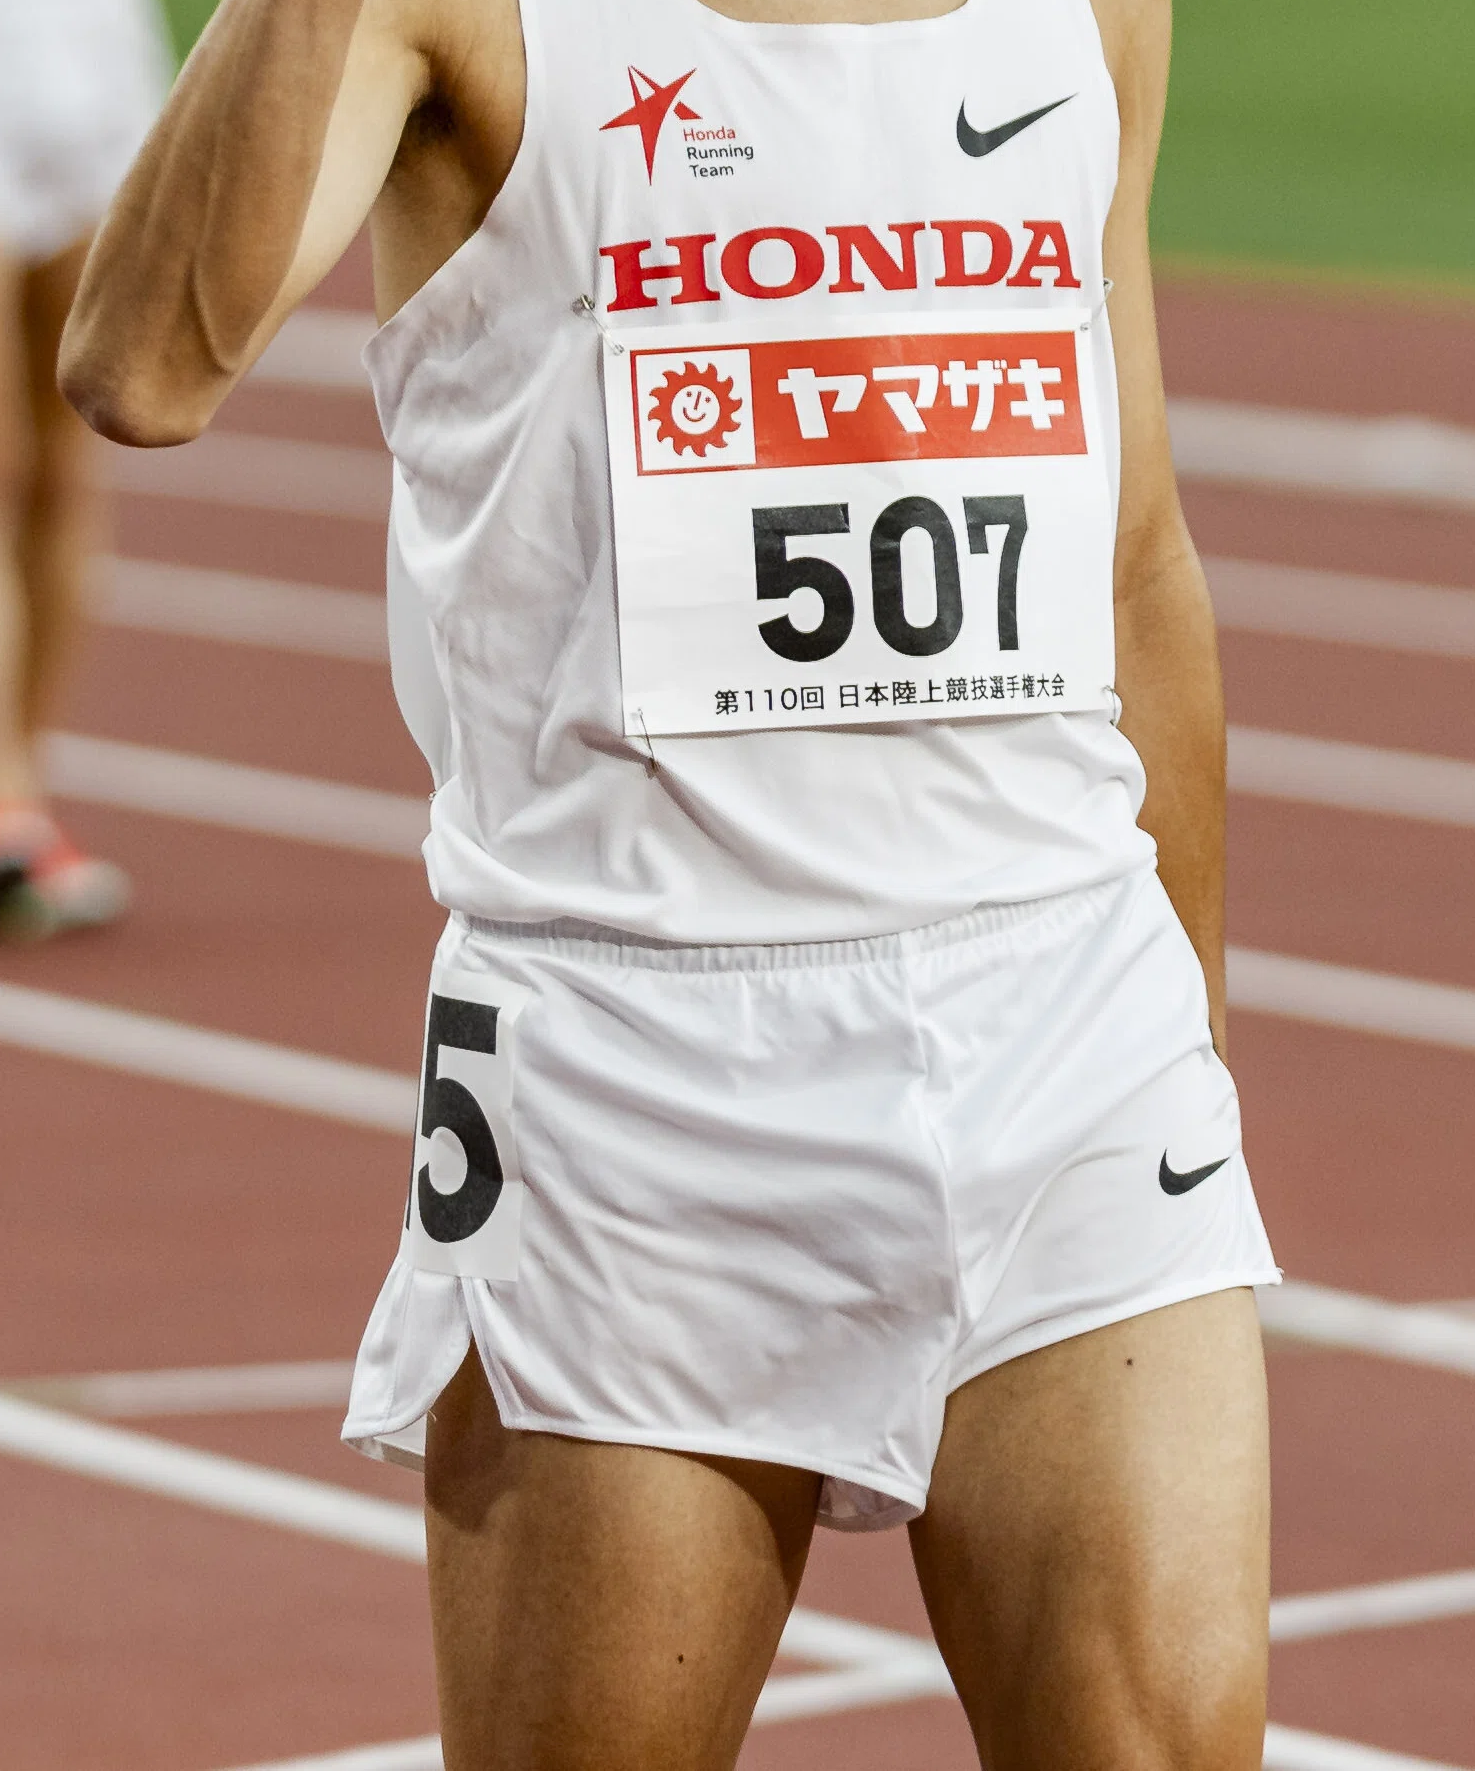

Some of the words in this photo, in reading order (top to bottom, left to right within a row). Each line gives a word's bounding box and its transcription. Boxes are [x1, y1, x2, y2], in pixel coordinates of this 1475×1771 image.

[683, 126, 737, 142] Honda
[686, 145, 754, 161] Running
[689, 164, 734, 178] Team
[599, 220, 1081, 312] HONDA
[778, 360, 1065, 439] ヤマザキ
[751, 495, 1028, 663] 507
[715, 686, 825, 716] 第110回
[840, 674, 1065, 709] 日本陸上競技選手権大会
[406, 992, 504, 1244] 5
